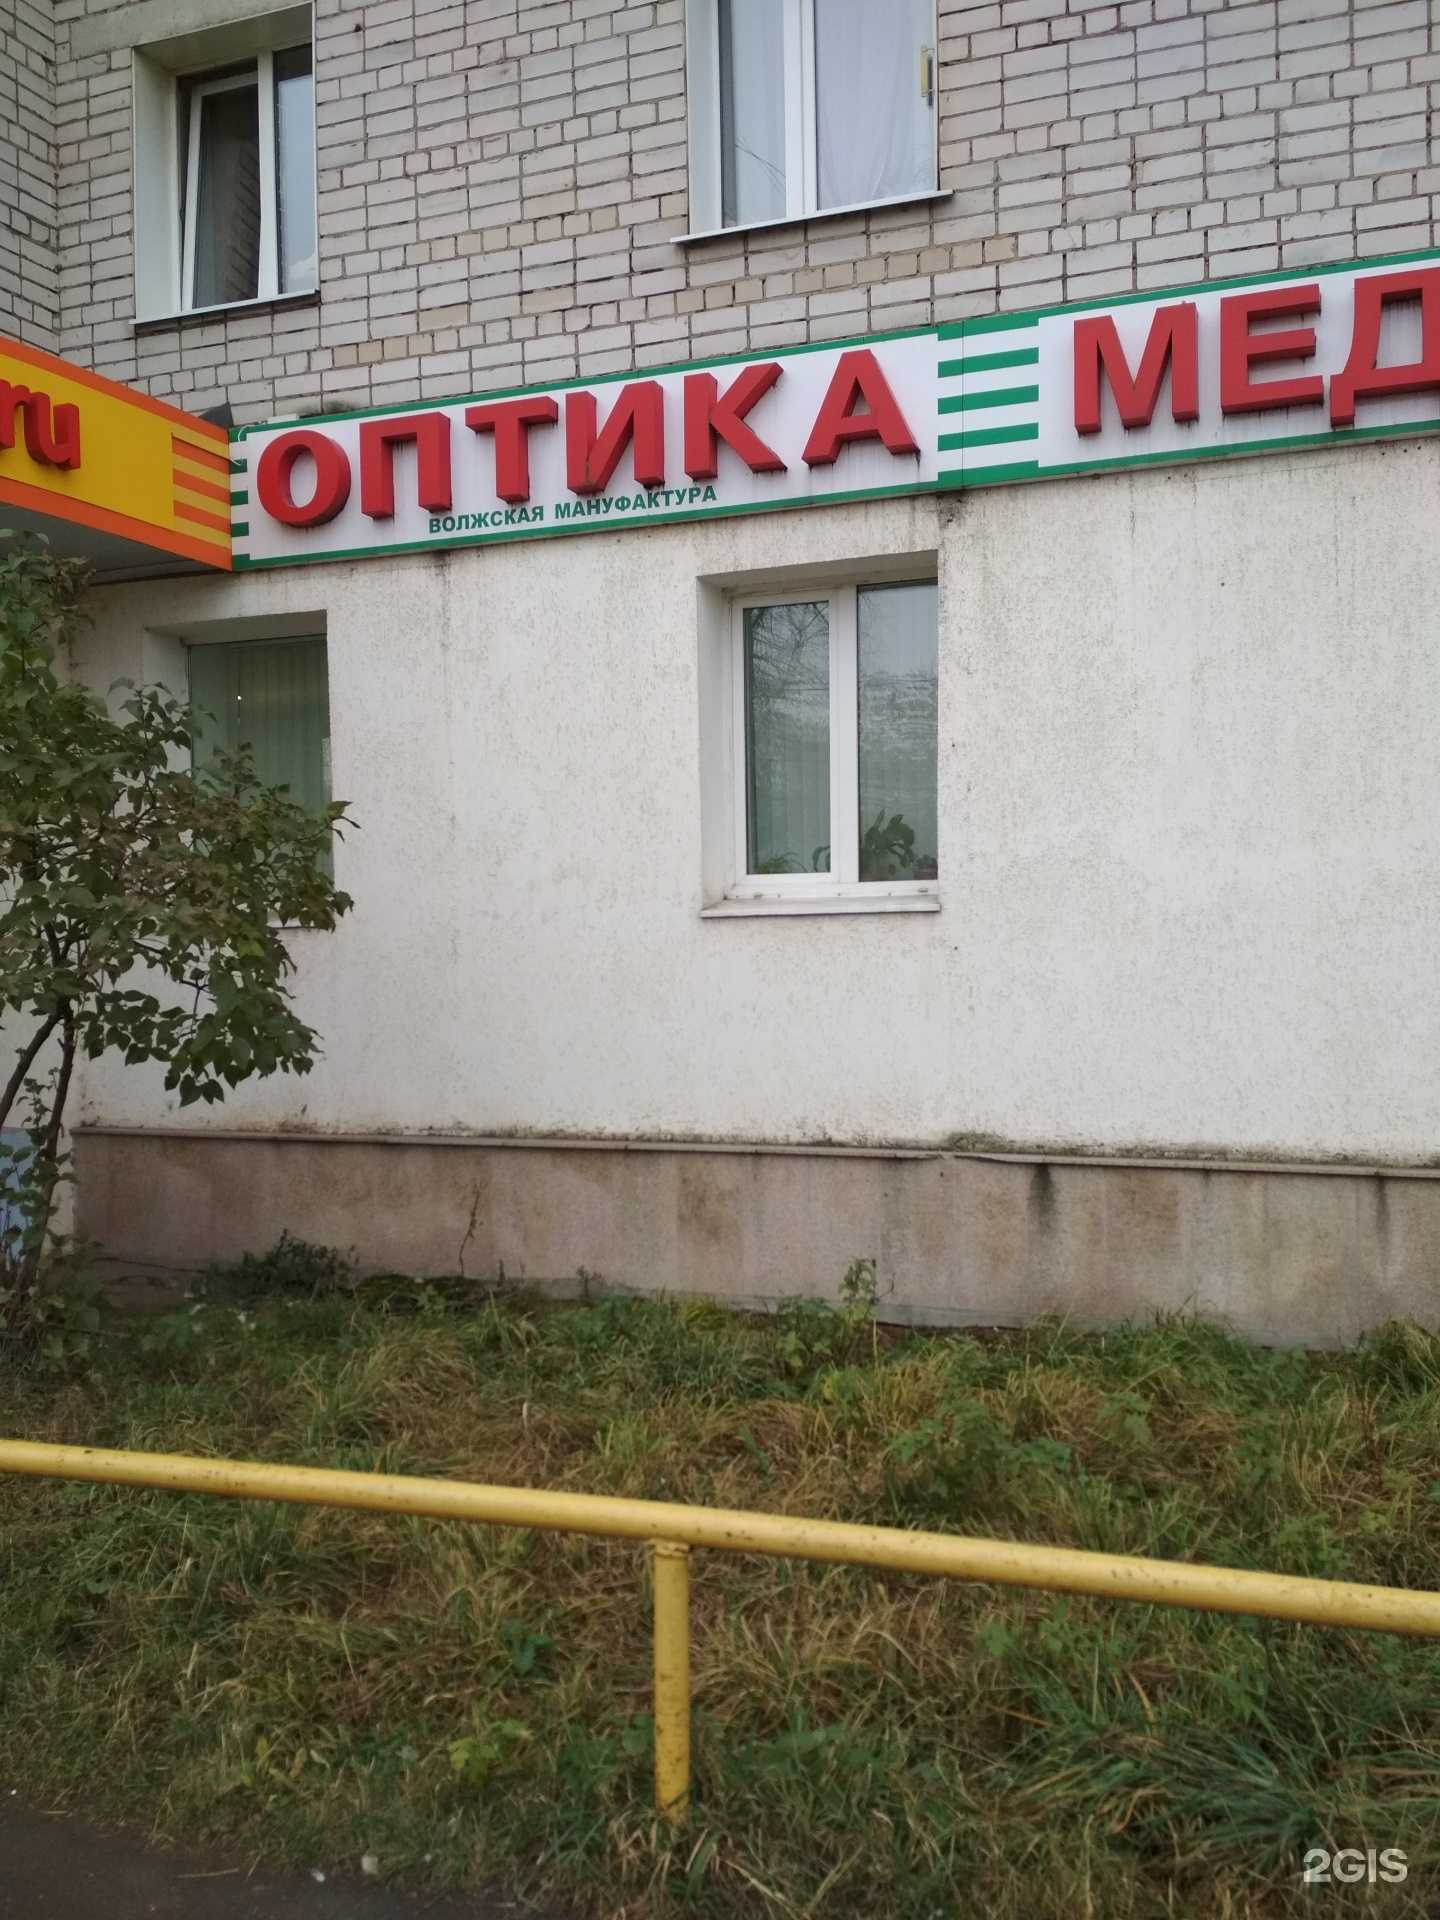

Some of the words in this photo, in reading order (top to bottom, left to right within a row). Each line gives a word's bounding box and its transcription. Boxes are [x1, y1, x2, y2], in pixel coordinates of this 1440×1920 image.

[256, 349, 920, 528] ОПТИКА
[428, 505, 545, 533] ВОЛЖСКАЯ
[554, 485, 717, 519] МАНУФАКТУРА
